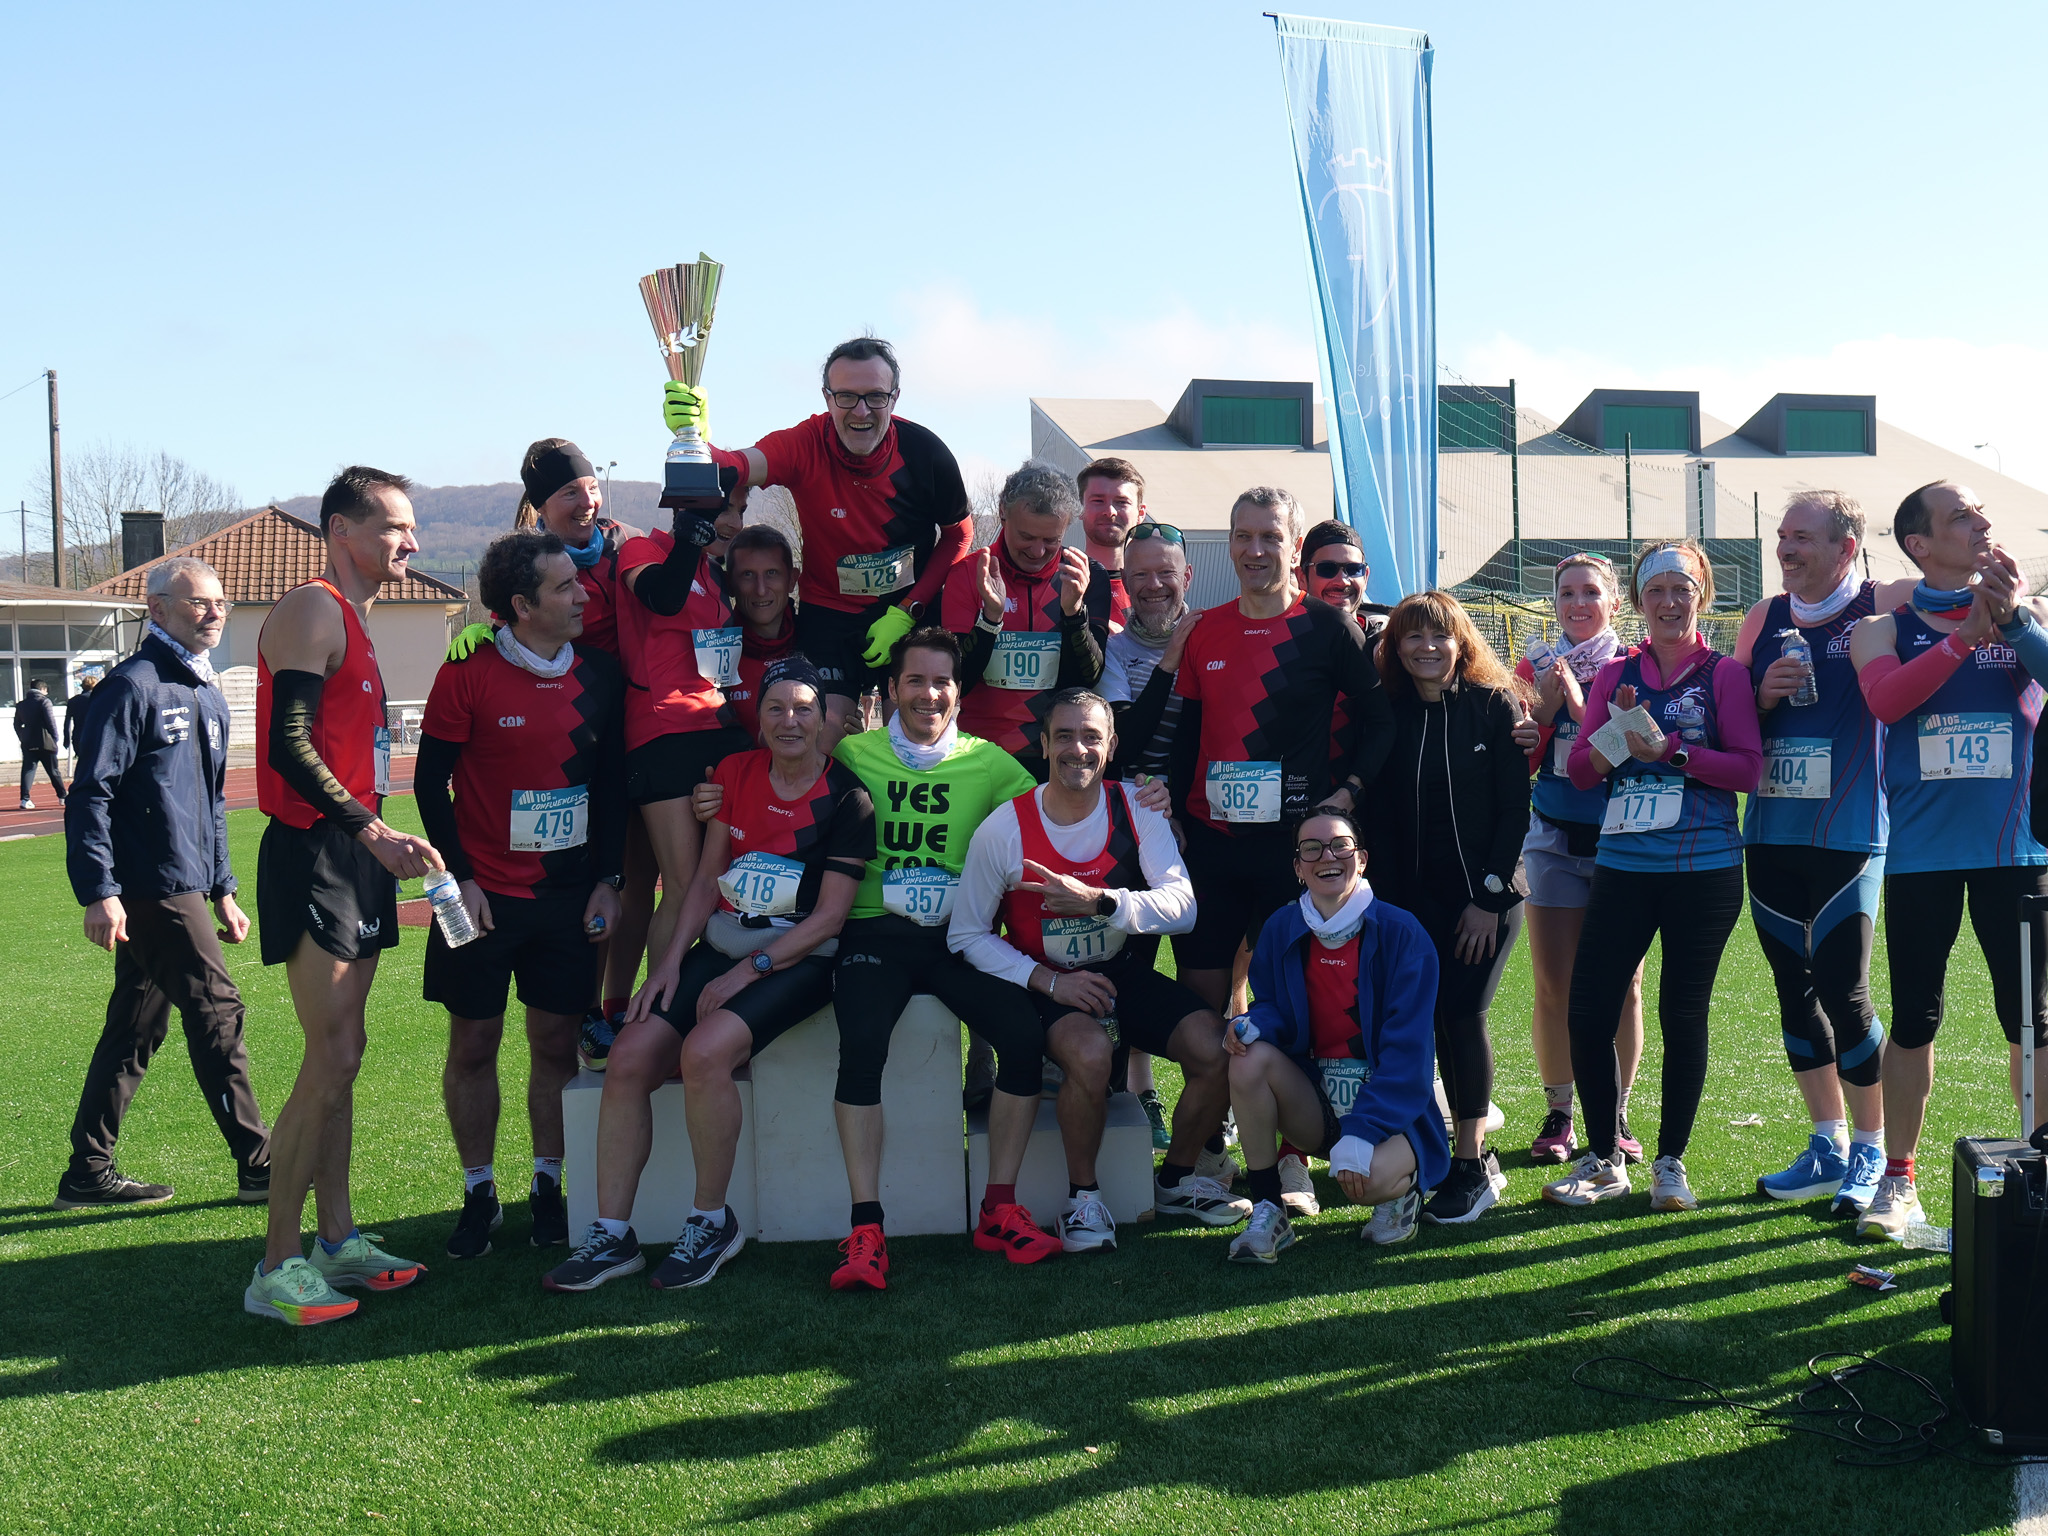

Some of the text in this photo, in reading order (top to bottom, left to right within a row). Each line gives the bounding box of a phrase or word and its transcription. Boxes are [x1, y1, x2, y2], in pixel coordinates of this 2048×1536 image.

[855, 550, 900, 569] CONFLUENCES
[861, 565, 897, 588] 128
[997, 640, 1046, 649] CONFLUENCES
[1001, 633, 1011, 642] 10
[714, 648, 730, 675] 73
[1979, 648, 2013, 661] OFP
[1003, 652, 1040, 678] 190
[1938, 721, 1994, 734] CONFLUENCES
[1942, 716, 1953, 726] 10
[1768, 746, 1814, 755] CONFLUENCES
[1772, 740, 1780, 748] 10
[1945, 735, 1989, 765] 143
[1219, 769, 1265, 780] CONFLUENCES
[1223, 764, 1230, 773] 10
[1769, 758, 1808, 785] 404
[531, 794, 579, 811] CONFLUENCES
[536, 793, 546, 803] 10
[887, 780, 950, 815] YES
[1221, 782, 1259, 809] 362
[767, 805, 789, 816] CRAFT
[1623, 795, 1658, 821] 171
[533, 809, 574, 839] 479
[884, 820, 949, 853] WE
[736, 862, 786, 872] CONFLUENCES
[905, 869, 915, 877] 10
[733, 871, 776, 903] 418
[901, 874, 951, 885] CONFLUENCES
[905, 887, 946, 914] 357
[308, 903, 323, 925] CRAFT
[1064, 920, 1075, 928] 10
[1065, 930, 1106, 959] 411
